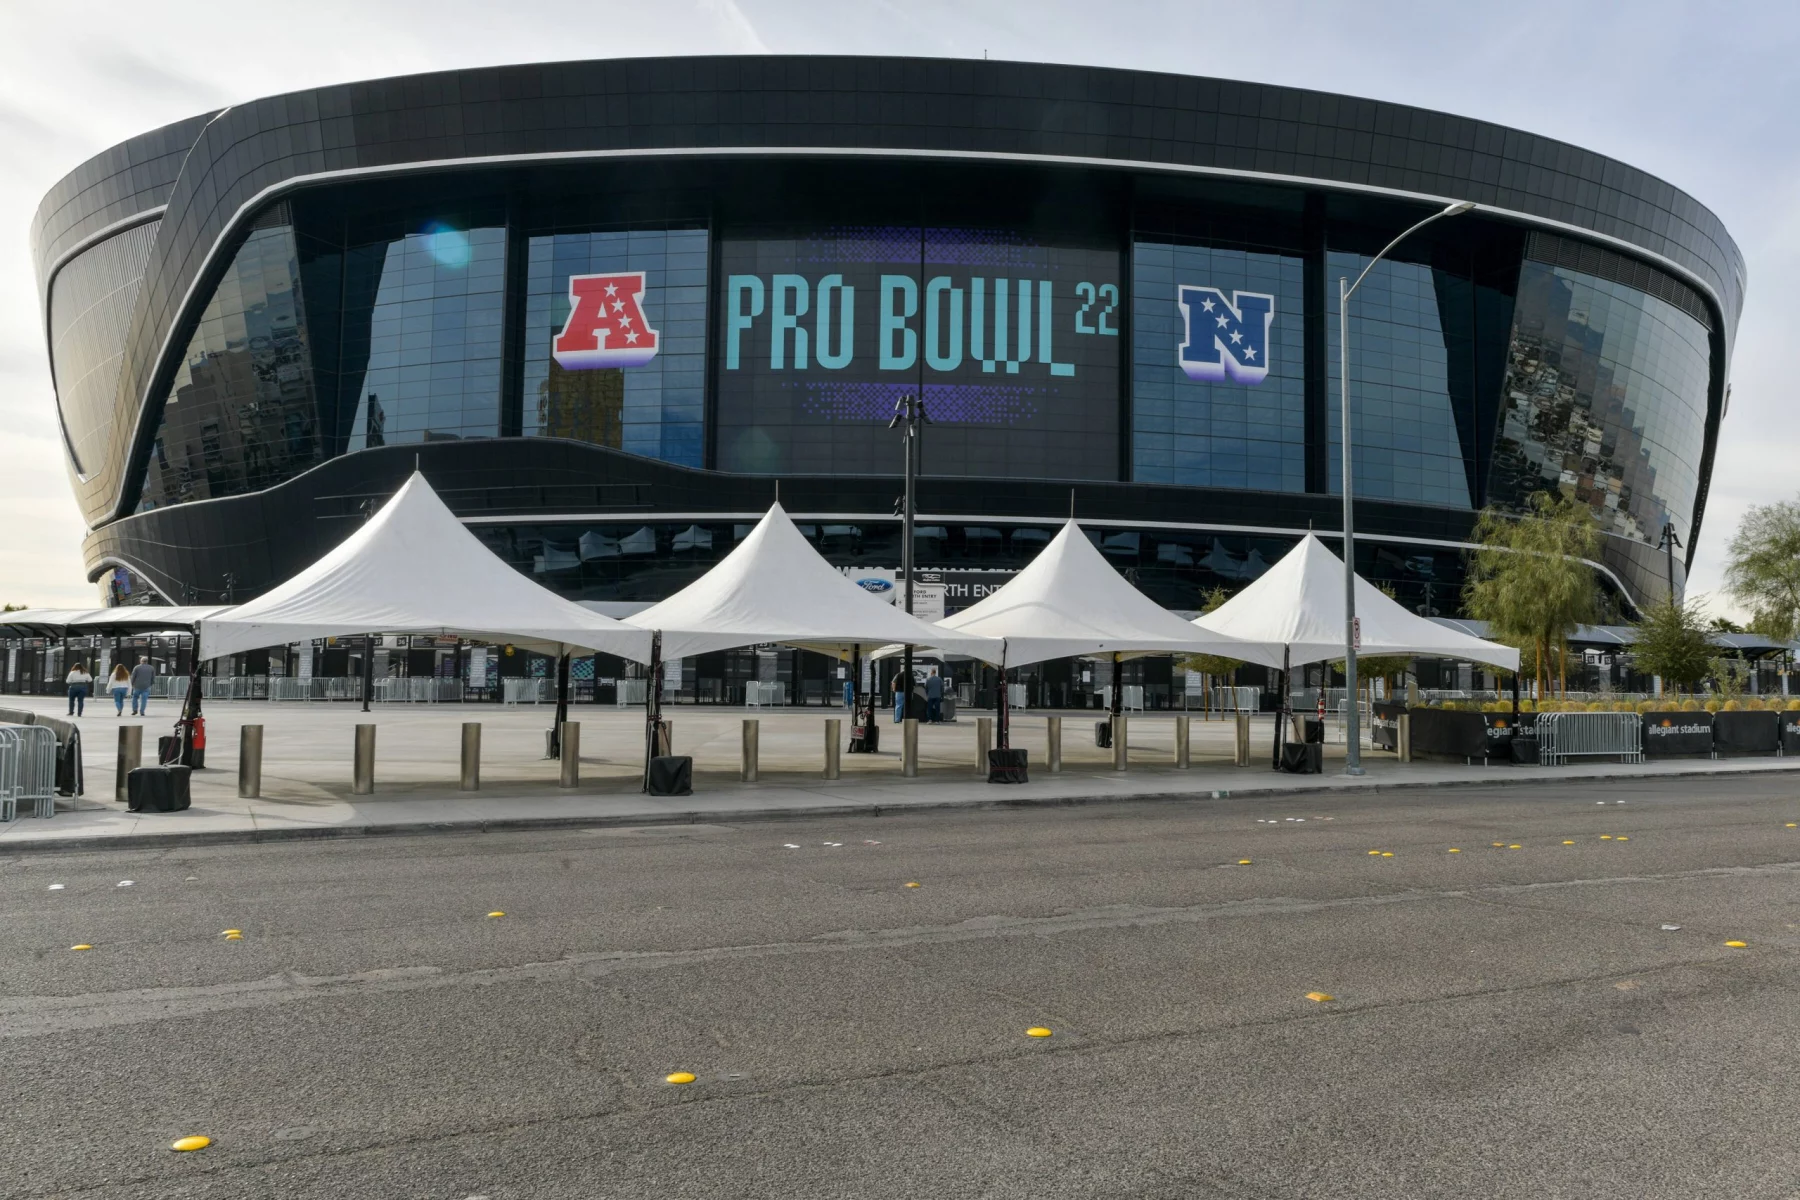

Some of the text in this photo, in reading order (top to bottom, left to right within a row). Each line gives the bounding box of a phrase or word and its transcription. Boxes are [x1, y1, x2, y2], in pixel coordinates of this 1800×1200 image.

[553, 271, 660, 370] A
[726, 274, 1119, 377] PRO BOWL 22
[1178, 284, 1275, 385] N
[862, 580, 886, 591] Ford
[943, 584, 1004, 597] RTH ENT
[1487, 726, 1513, 738] egian
[1648, 723, 1711, 737] allegiant stadium
[1786, 722, 1800, 735] alleg
